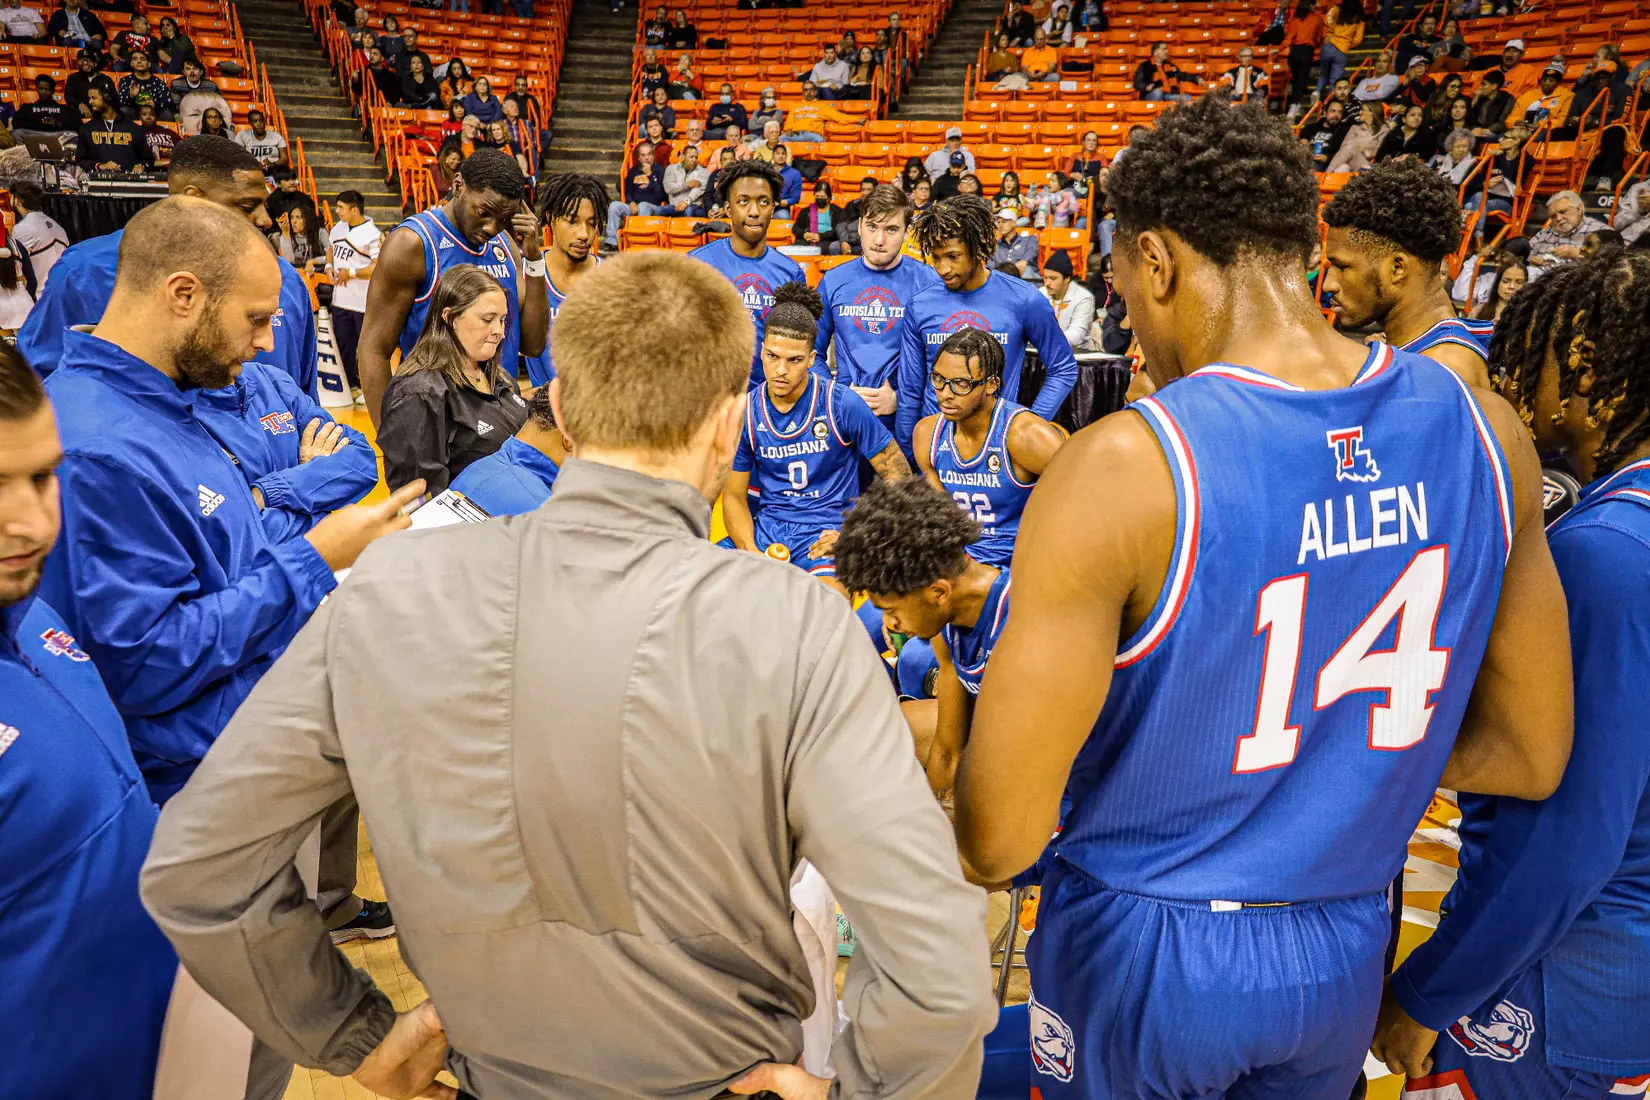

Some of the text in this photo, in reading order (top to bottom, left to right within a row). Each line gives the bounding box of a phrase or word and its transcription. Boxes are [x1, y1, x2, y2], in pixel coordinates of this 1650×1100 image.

[91, 131, 133, 145] UTEP
[333, 244, 355, 261] UTEP
[838, 305, 886, 318] LOUISIANA
[317, 326, 344, 393] UTEP
[759, 439, 830, 459] LOUISIANA
[787, 460, 808, 490] 0
[938, 469, 1001, 488] LOUISIANA
[952, 491, 996, 523] 22
[1297, 481, 1429, 566] ALLEN
[1231, 543, 1452, 775] 14
